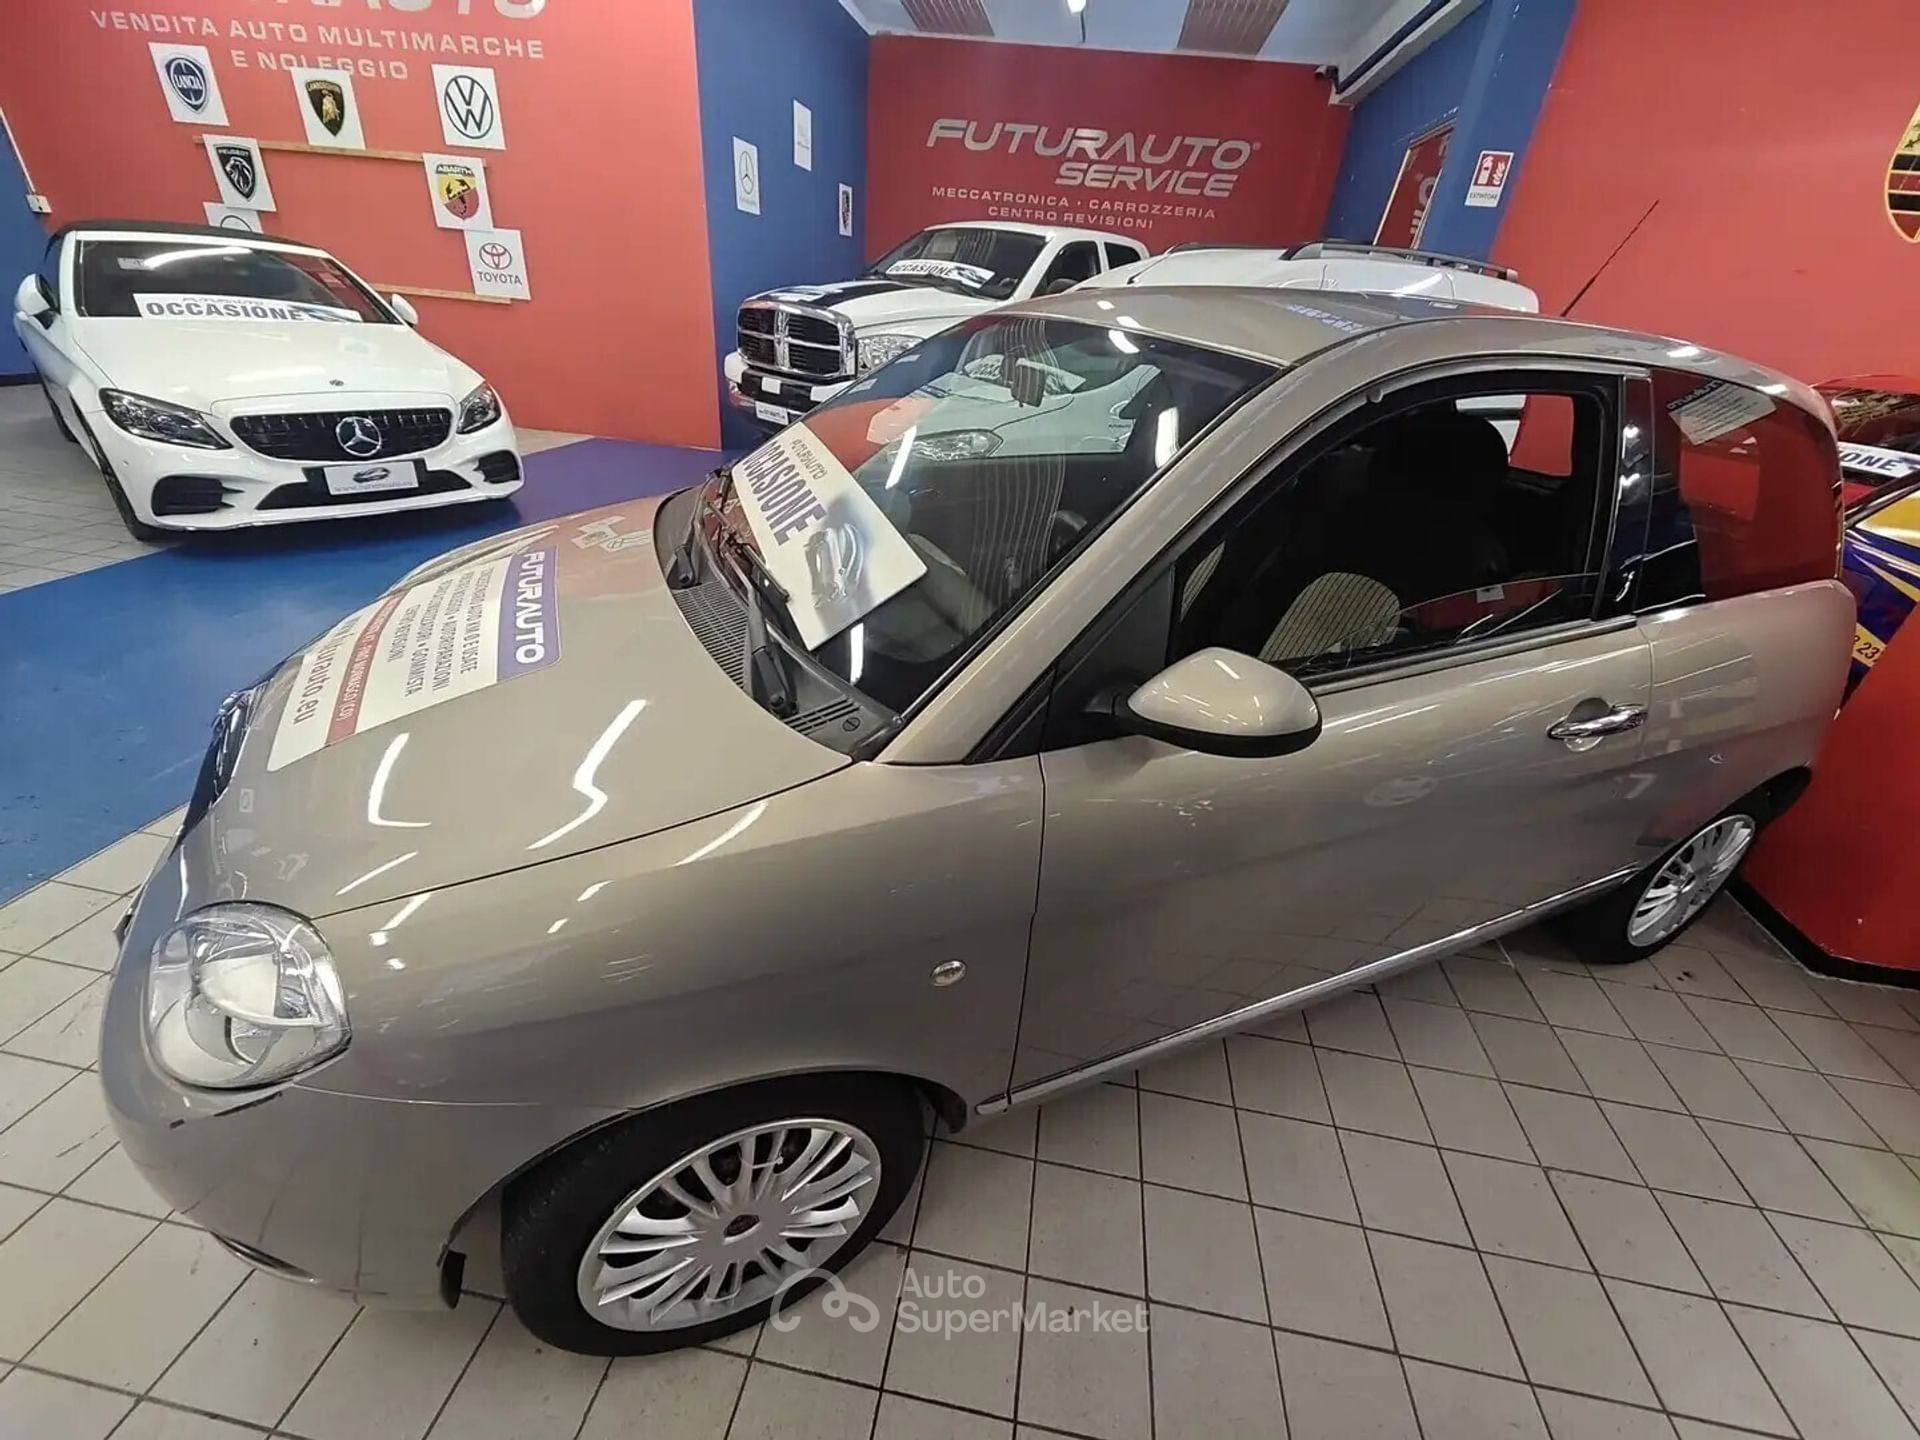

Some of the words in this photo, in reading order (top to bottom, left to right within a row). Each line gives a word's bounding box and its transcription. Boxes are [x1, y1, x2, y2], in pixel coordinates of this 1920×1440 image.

[90, 10, 219, 36] VENDITA
[229, 20, 308, 42] AUTO
[318, 26, 544, 59] MULTIMARCHE
[231, 49, 248, 68] E
[174, 73, 202, 91] LANCIA
[926, 118, 1251, 170] FUTURAUTO
[437, 164, 475, 176] ABARTH
[1054, 162, 1239, 198] SERVICE
[932, 186, 1069, 207] MECCATRONICA
[1089, 199, 1216, 219] CARROZZERIA
[988, 207, 1058, 221] CENTRO
[1063, 212, 1154, 229] REVISIONI
[477, 271, 523, 286] TOYOTA
[888, 263, 954, 277] OCCASIONE
[146, 302, 304, 321] OCCASIONE
[1842, 450, 1898, 472] ONE
[741, 440, 827, 546] OCCASIONE
[515, 551, 546, 665] FUTURAUTO
[431, 620, 458, 691] AUTORIPARAZIONI
[460, 649, 479, 674] USATE
[405, 647, 430, 696] GOMMISTA
